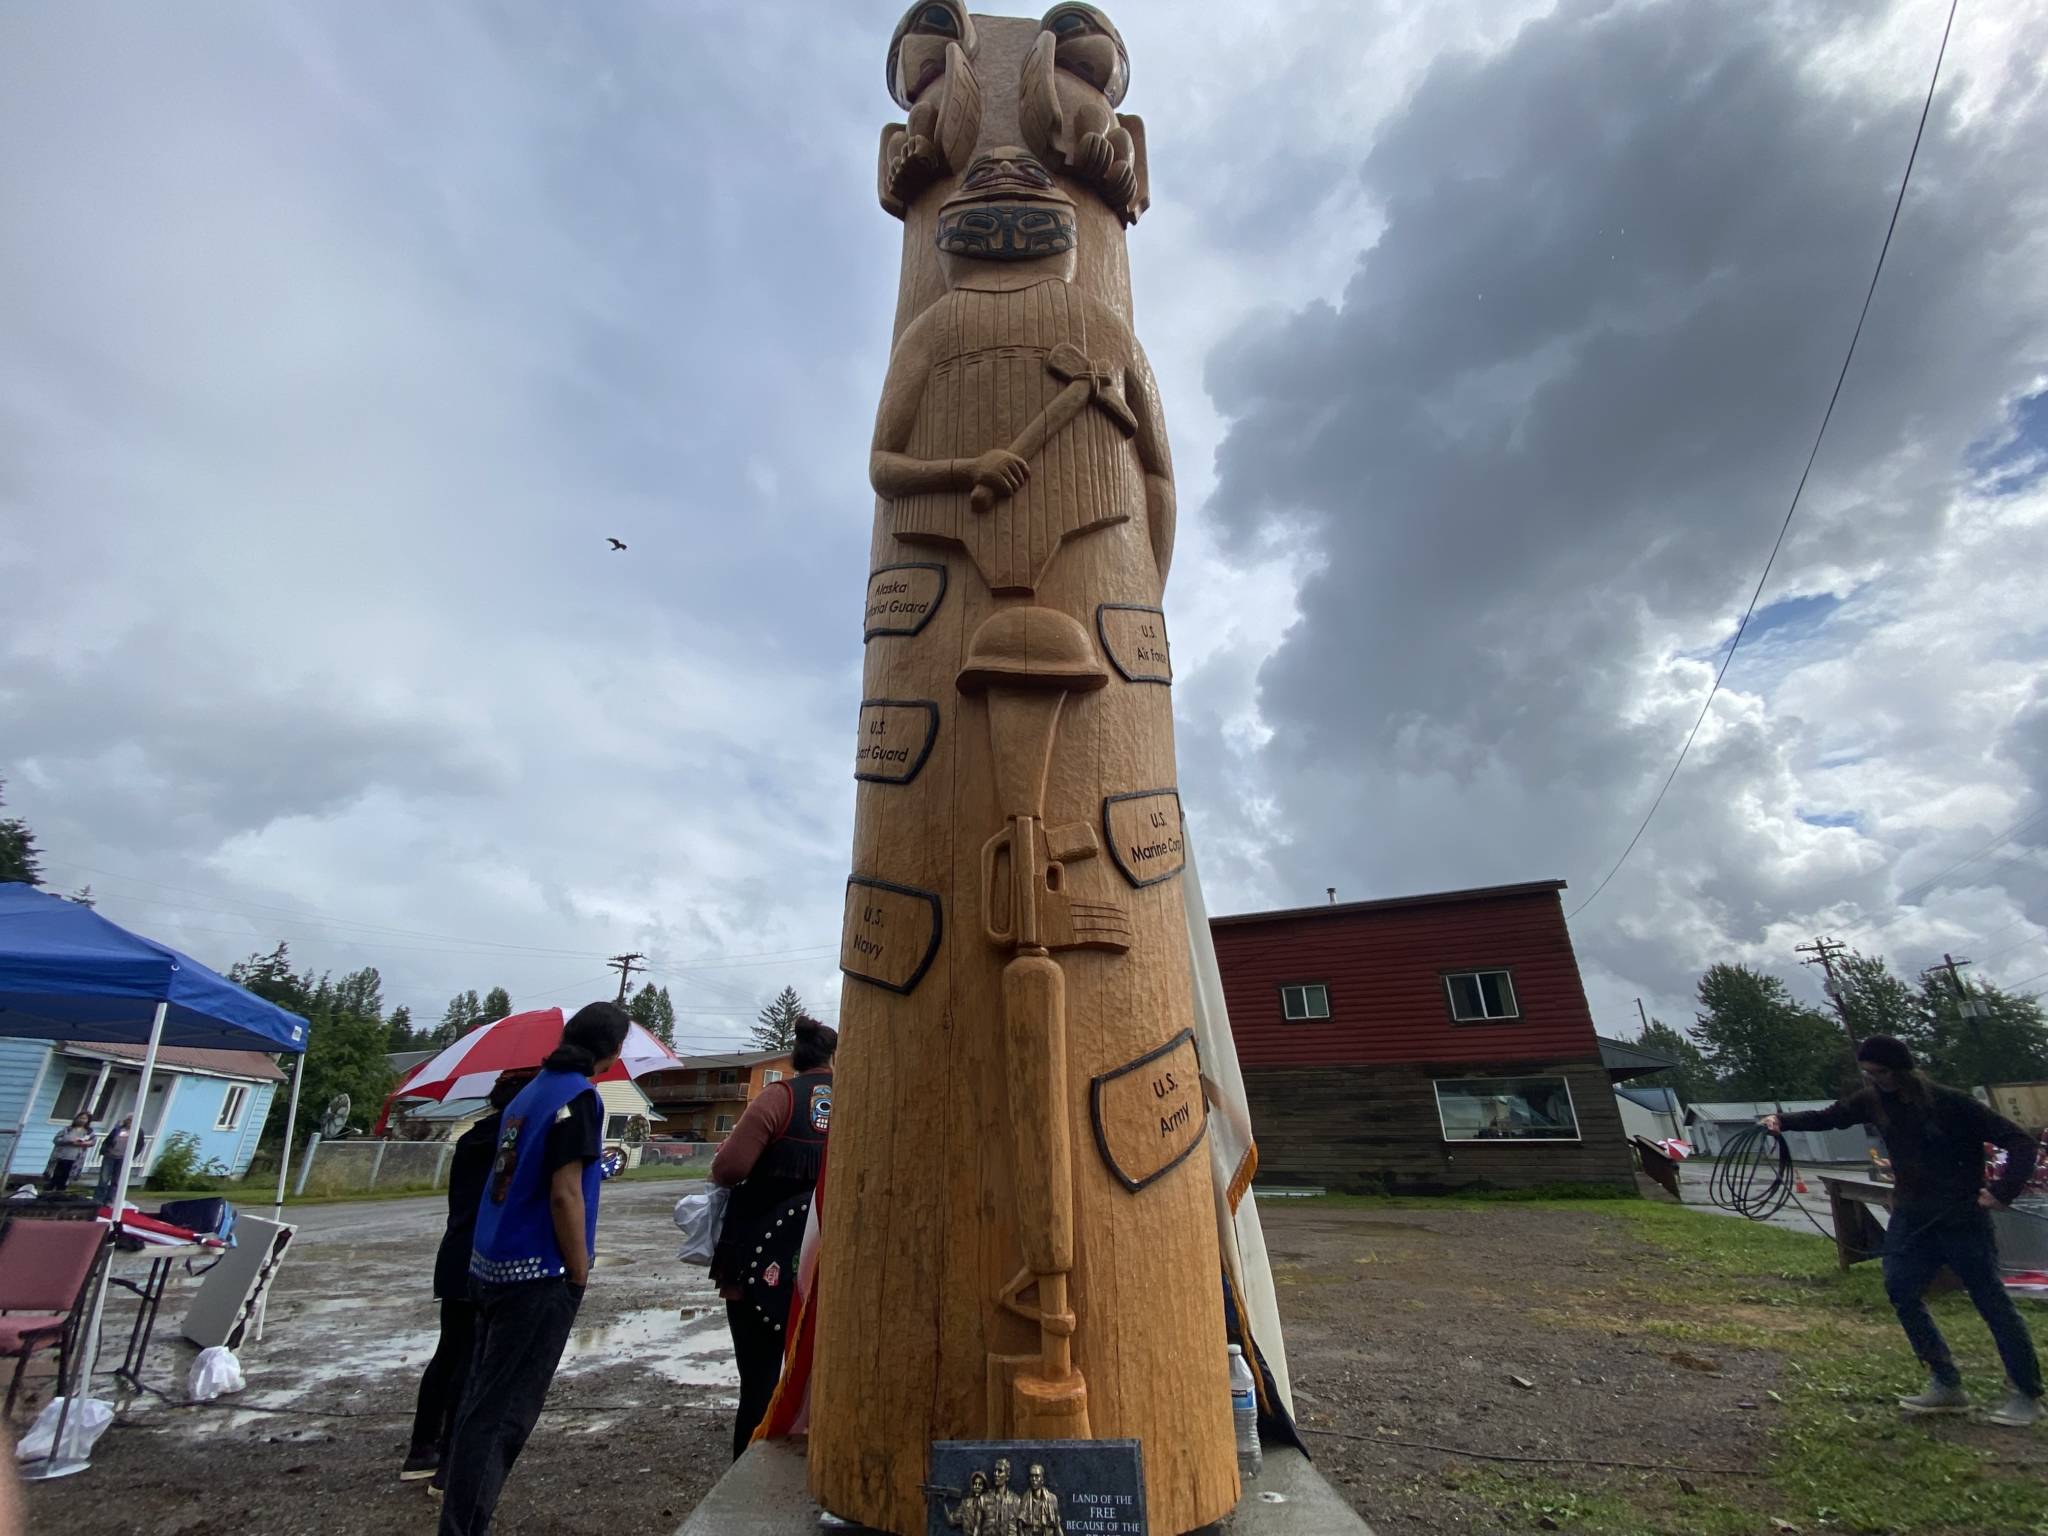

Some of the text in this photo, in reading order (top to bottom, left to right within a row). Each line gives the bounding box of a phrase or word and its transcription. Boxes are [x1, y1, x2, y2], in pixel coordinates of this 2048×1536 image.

[889, 600, 929, 613] Guard
[1138, 647, 1149, 661] Air
[870, 720, 887, 735] U.S.
[871, 745, 909, 763] Guard
[1150, 812, 1167, 828] U.S.
[1131, 841, 1167, 863] Marine
[863, 906, 884, 928] U.S.
[853, 934, 884, 960] Navy
[1152, 1073, 1179, 1098] U.S.
[1159, 1102, 1190, 1138] Army
[1072, 1493, 1132, 1505] LAND OF THE
[1090, 1506, 1116, 1519] FREE
[1066, 1520, 1140, 1533] BECAUSE OF THE
